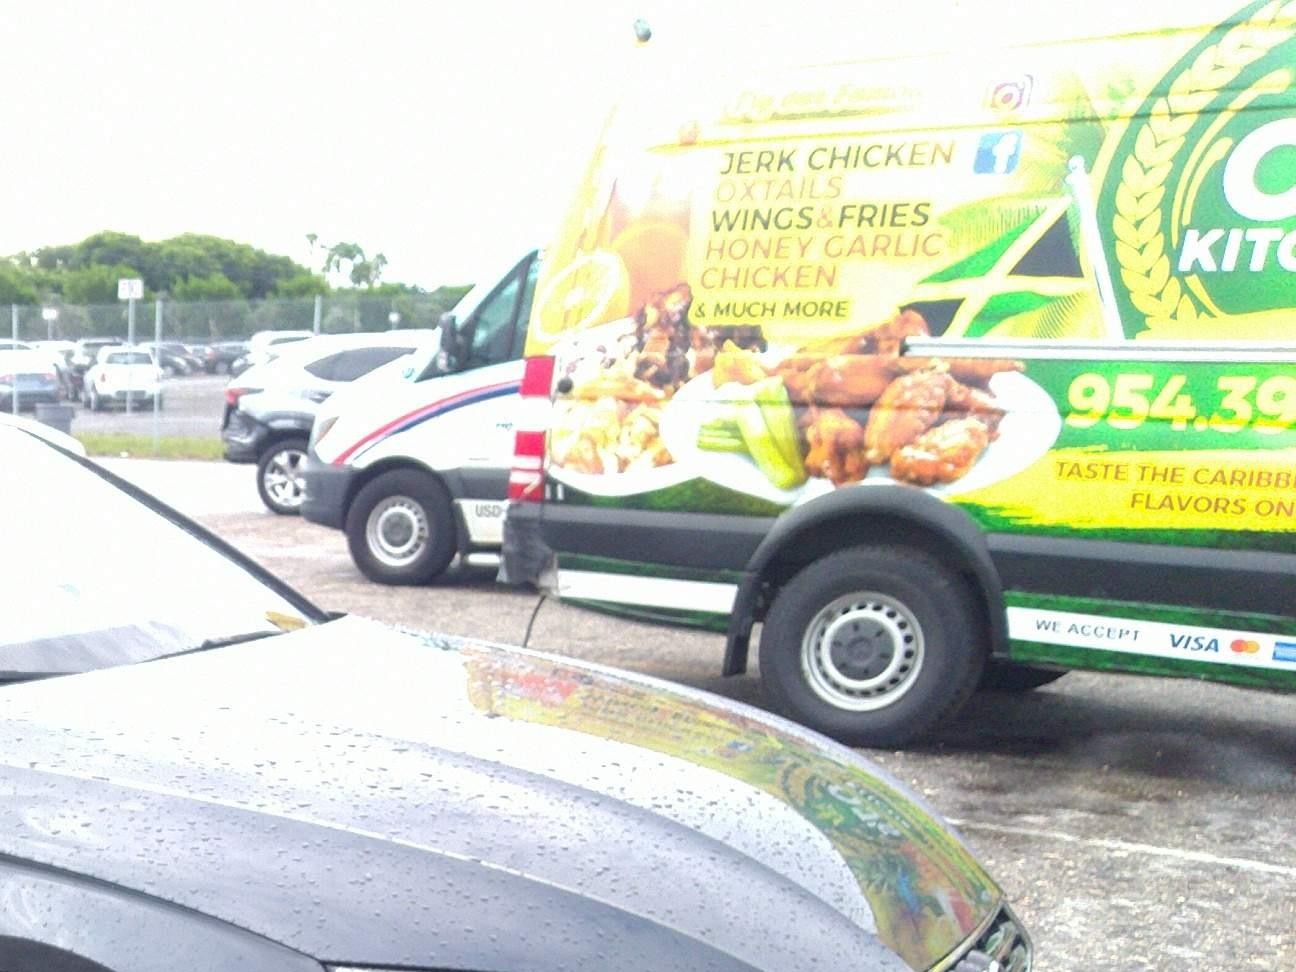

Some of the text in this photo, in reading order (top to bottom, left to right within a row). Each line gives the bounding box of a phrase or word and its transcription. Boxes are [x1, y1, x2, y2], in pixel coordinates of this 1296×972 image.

[720, 142, 954, 174] JERK CHICKEN
[717, 176, 843, 202] OXTAILS
[705, 233, 944, 261] HONEY GARLIC
[700, 264, 837, 290] CHICKEN
[694, 300, 848, 318] & MUCH MORE
[1065, 373, 1296, 433] 954.39
[1056, 461, 1296, 489] TASTE THE CARIBB
[1130, 493, 1295, 517] FLAVORS ON
[1035, 619, 1142, 642] WE ACCEPT
[1169, 633, 1220, 653] VISA
